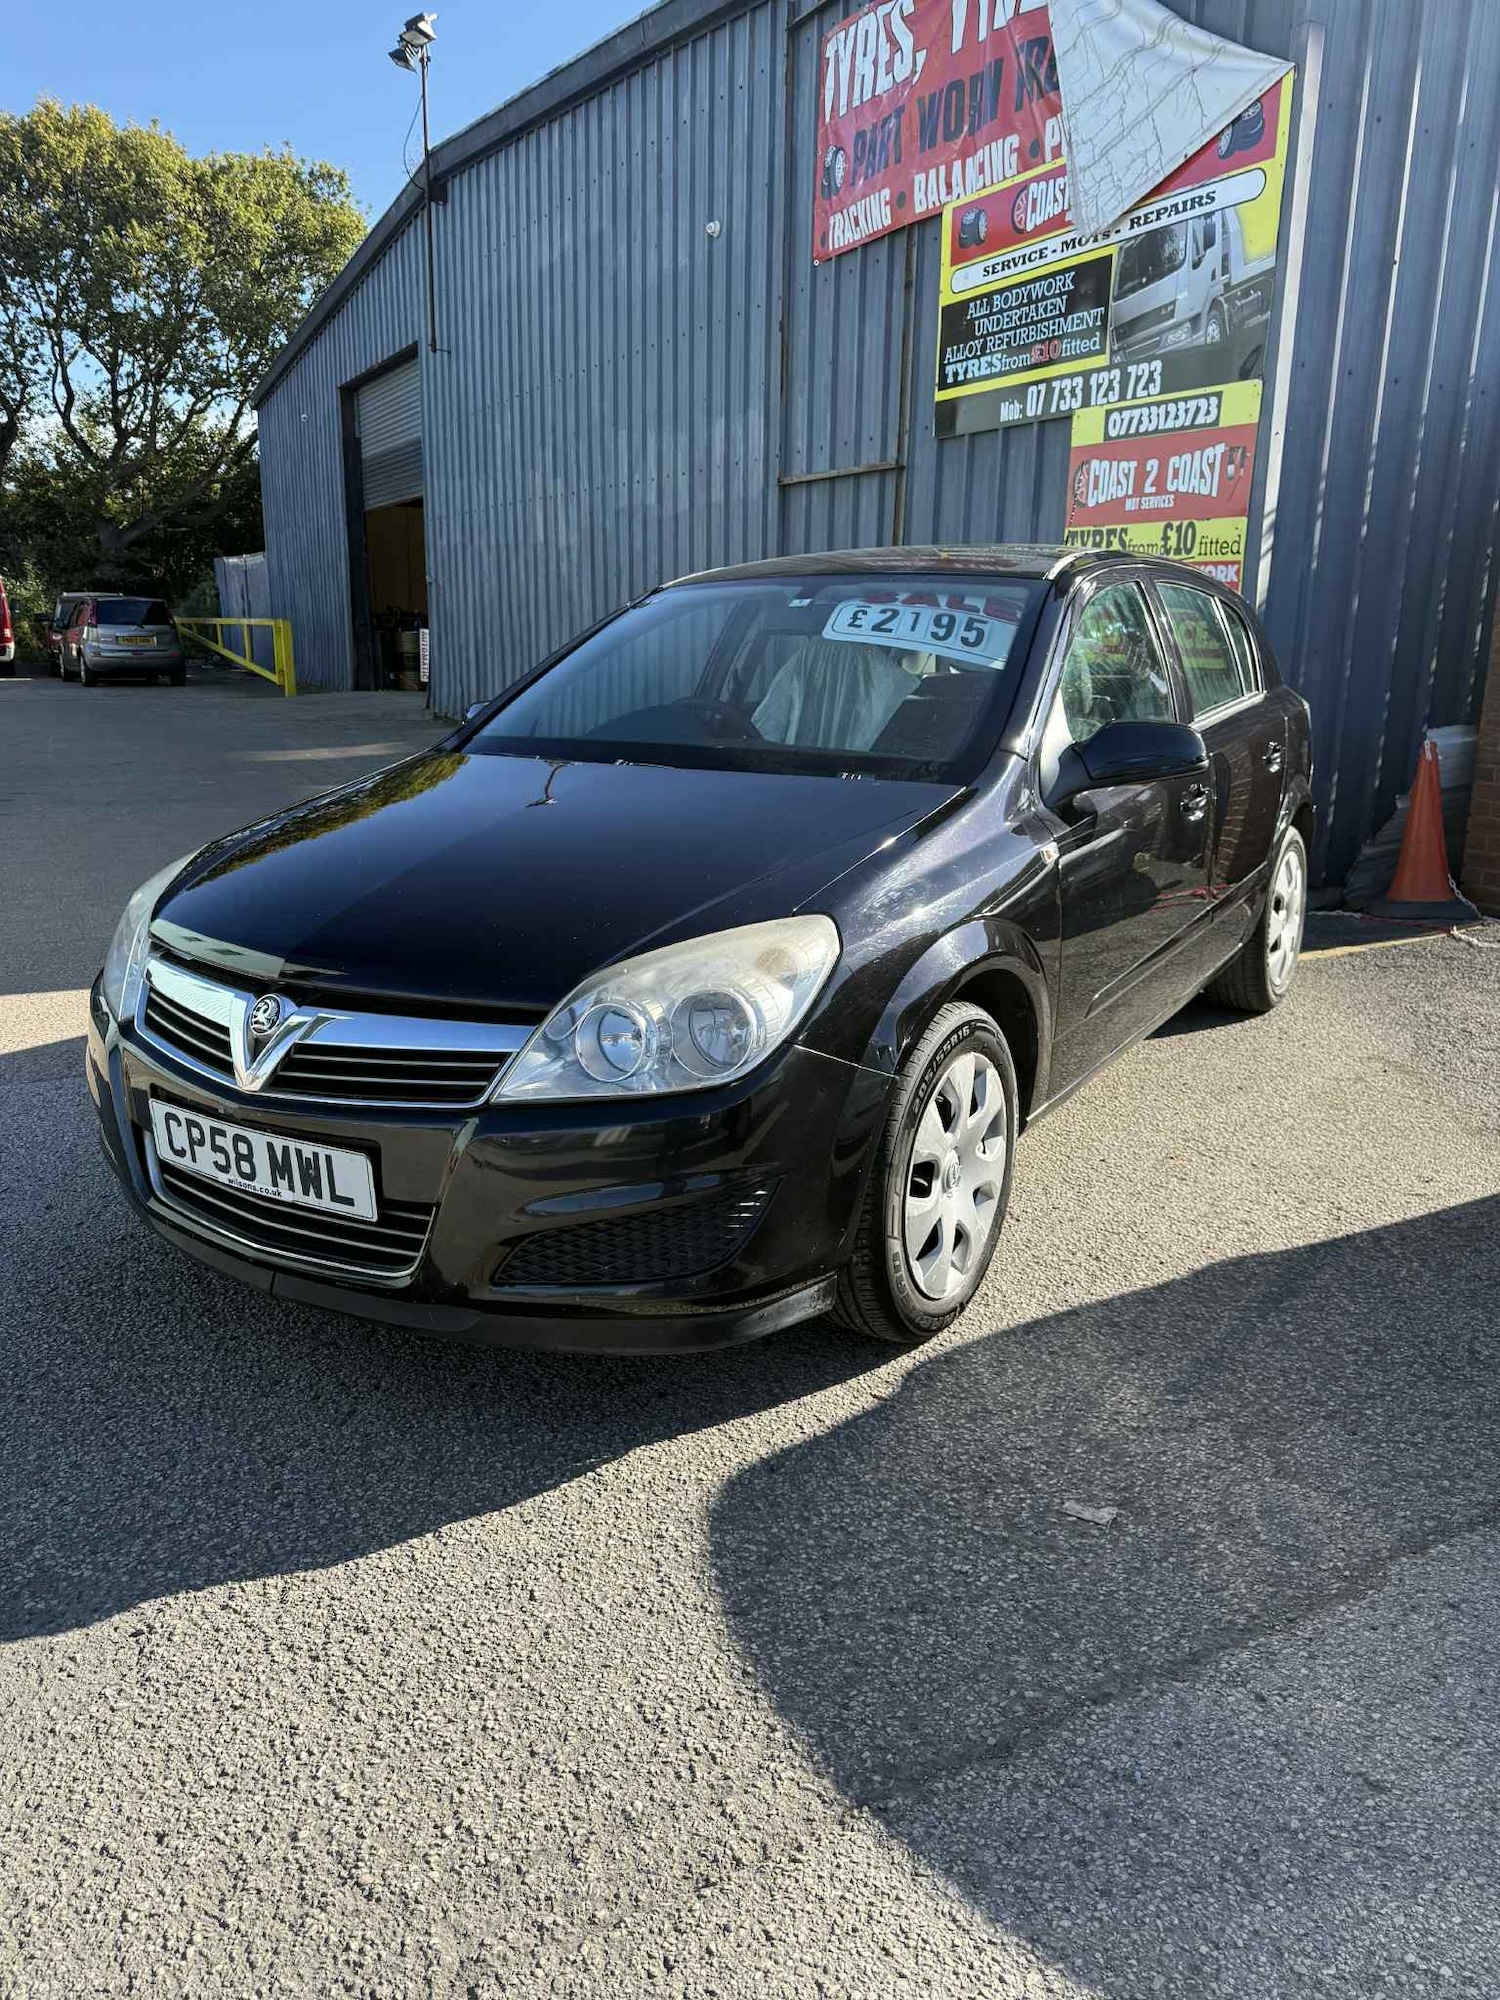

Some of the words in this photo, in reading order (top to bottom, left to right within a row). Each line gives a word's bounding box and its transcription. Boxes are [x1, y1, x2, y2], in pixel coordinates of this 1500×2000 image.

[825, 0, 927, 124] TYRES,
[851, 103, 906, 188] PART
[918, 57, 1004, 155] WORN
[828, 187, 892, 250] TRACKING
[914, 133, 1020, 214] BALANCING
[982, 246, 1048, 277] SERVICE
[1128, 191, 1217, 231] REPAIRS
[967, 298, 990, 320] ALL
[993, 271, 1077, 312] BODYWORK
[974, 295, 1069, 336] UNDERTAKEN
[944, 337, 985, 364] ALLOY
[986, 307, 1105, 353] REFURBISHMENT
[945, 354, 1002, 384] TYRES
[1001, 352, 1031, 371] from
[1061, 332, 1100, 357] fitted
[1026, 383, 1047, 417] 07
[1050, 376, 1084, 413] 733
[1089, 368, 1121, 406] 123
[1126, 360, 1163, 400] 723
[1107, 396, 1219, 437] 07733123723
[1088, 458, 1138, 507] COAST
[1144, 458, 1160, 494] 2
[1166, 443, 1226, 497] COAST
[1140, 494, 1175, 509] SERVICES
[1160, 520, 1197, 556] £10
[1199, 535, 1242, 557] fitted
[421, 631, 430, 680] AUTOMATIC
[164, 1111, 257, 1182] CP58
[266, 1140, 355, 1208] MWL
